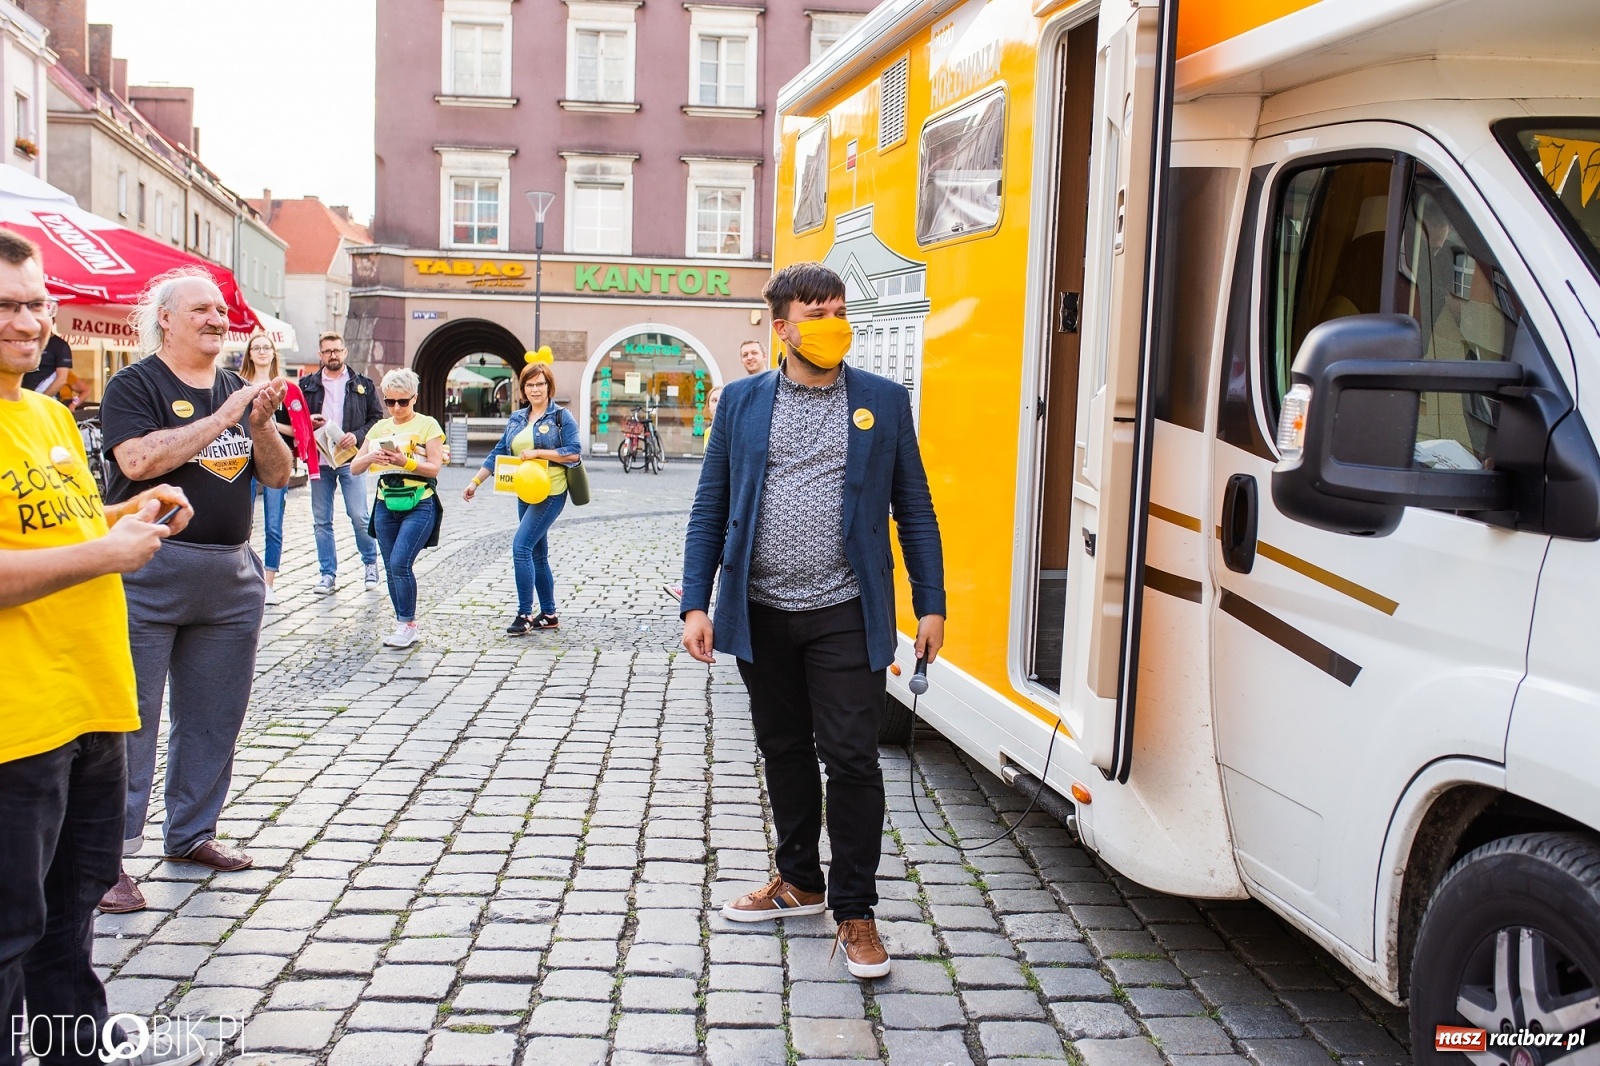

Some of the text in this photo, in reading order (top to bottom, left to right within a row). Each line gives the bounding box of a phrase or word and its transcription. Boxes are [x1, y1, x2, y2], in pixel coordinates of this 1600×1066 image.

[38, 214, 117, 269] WARKA
[413, 259, 525, 277] TABAC
[575, 265, 730, 295] KANTOR
[72, 318, 139, 337] RACIBO
[625, 343, 681, 356] KANTOR
[598, 367, 611, 434] KANTOR
[694, 369, 705, 436] KANTOR
